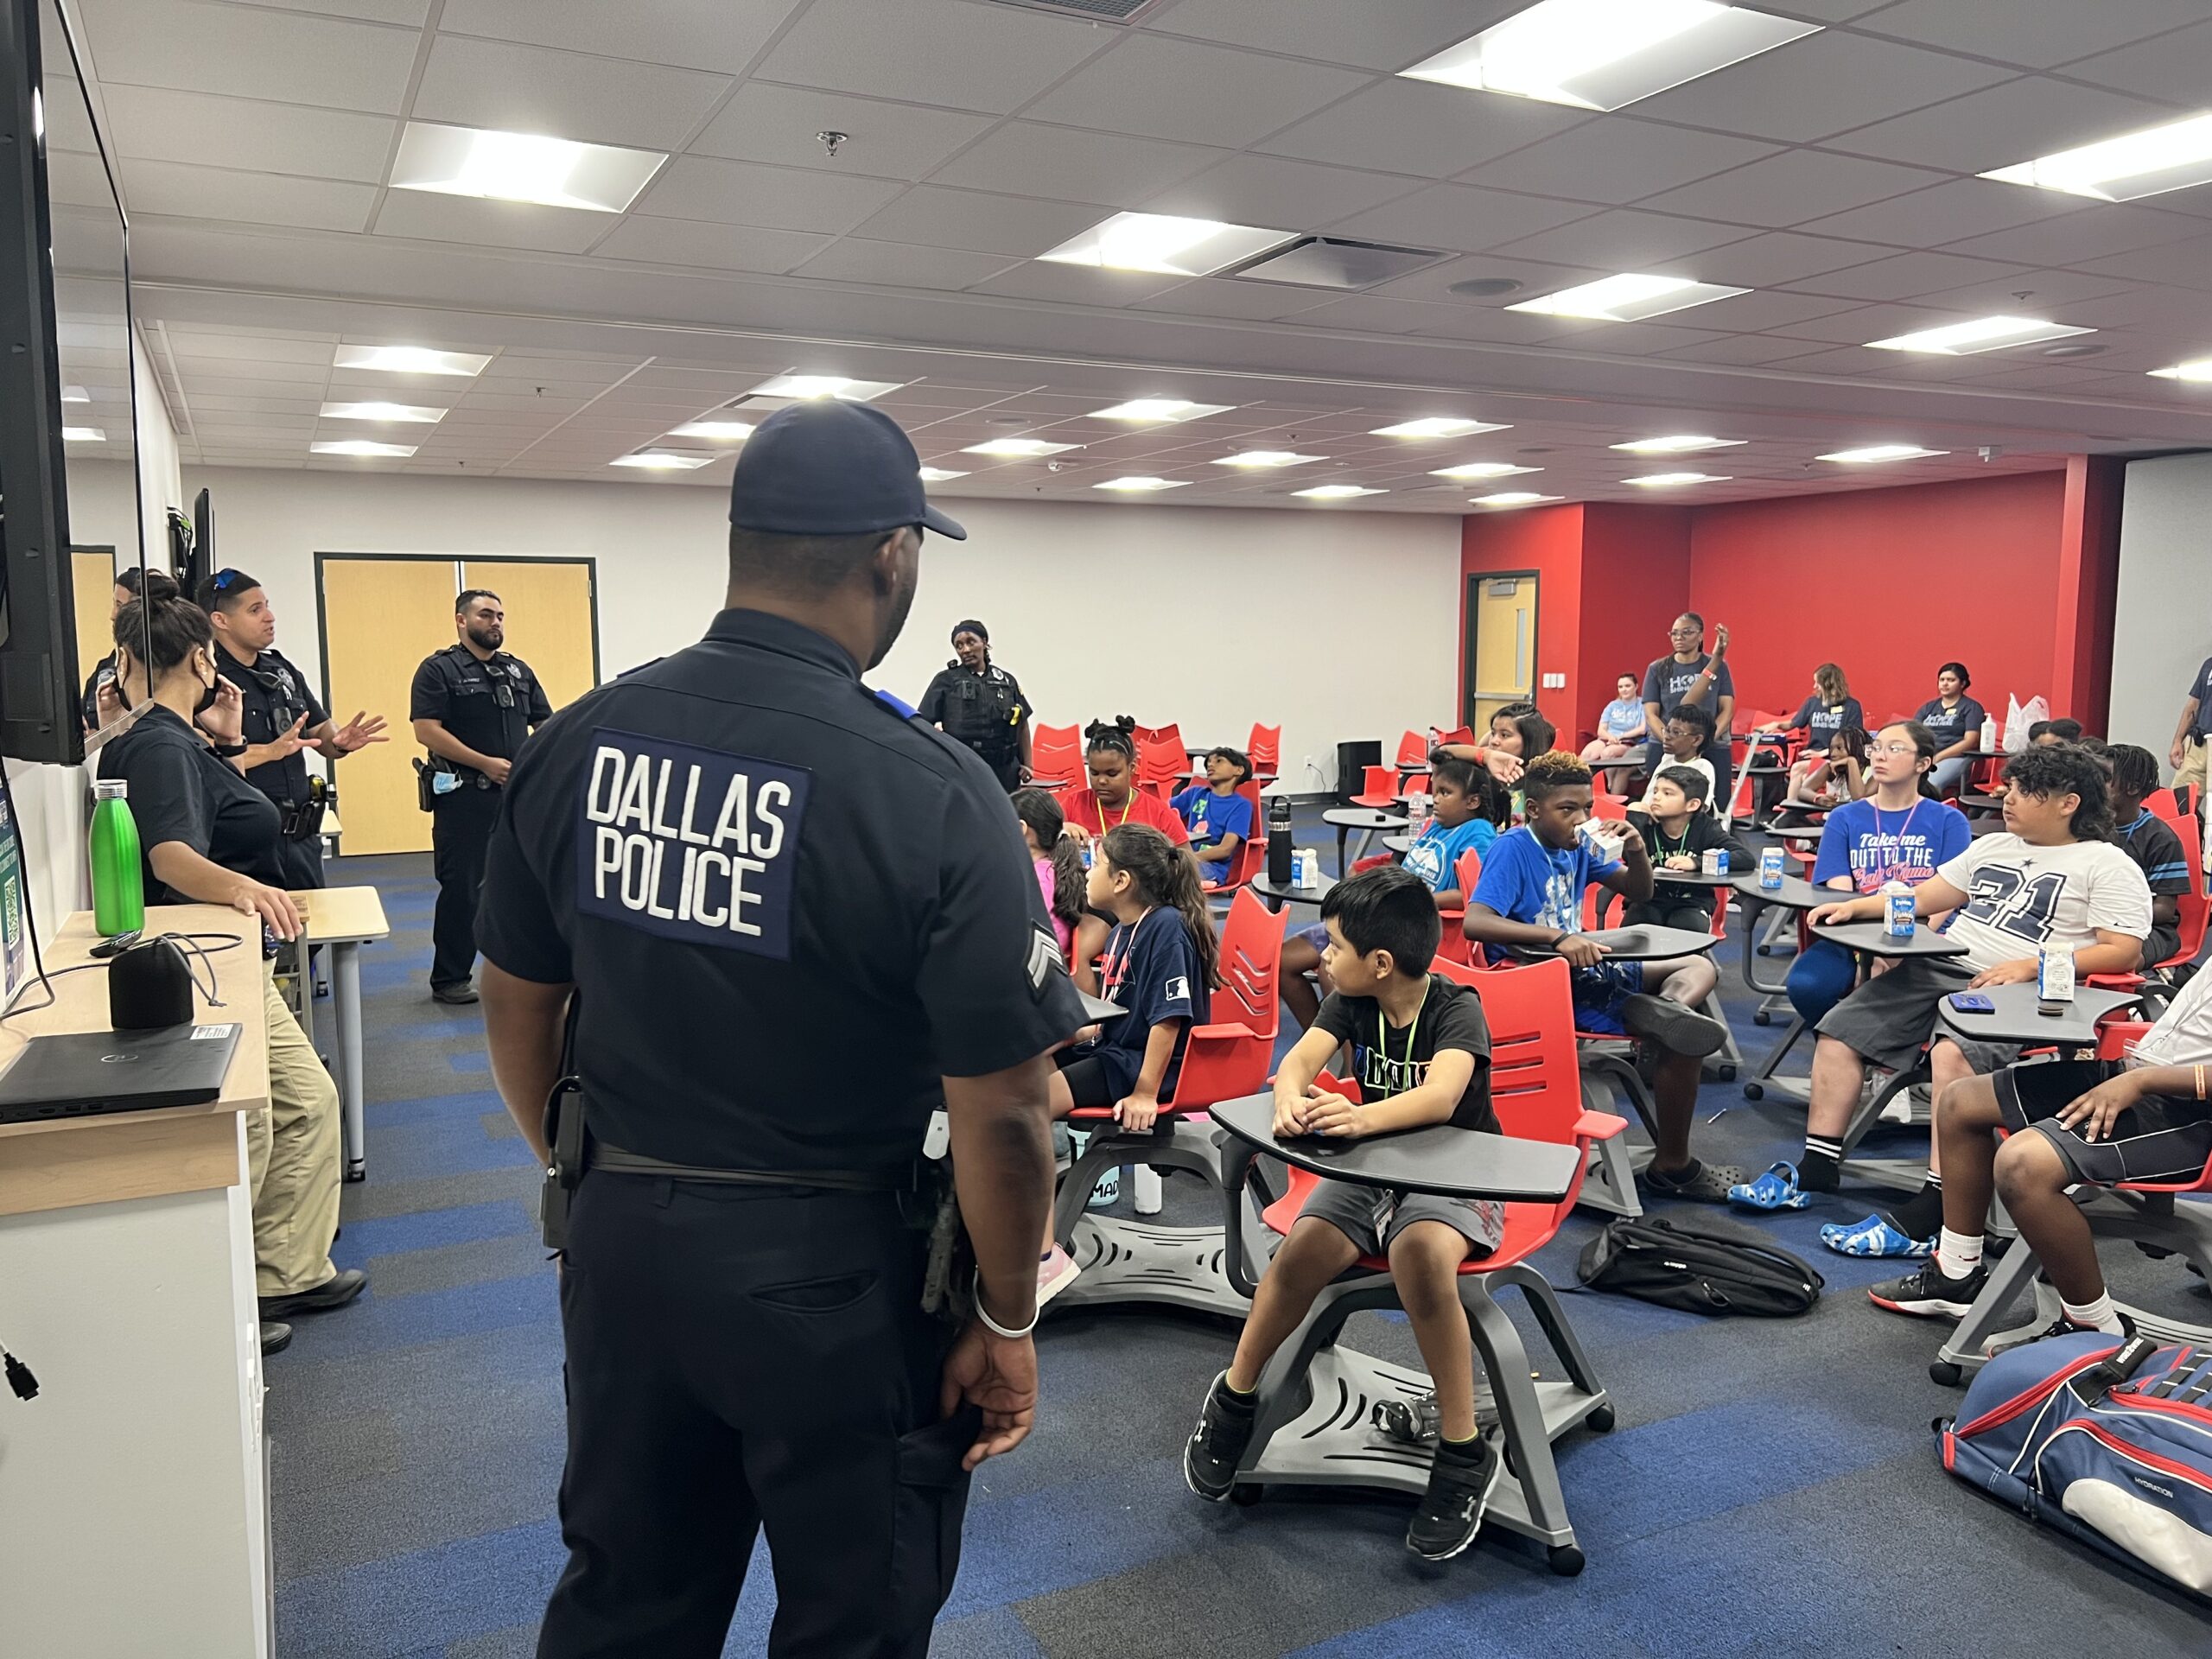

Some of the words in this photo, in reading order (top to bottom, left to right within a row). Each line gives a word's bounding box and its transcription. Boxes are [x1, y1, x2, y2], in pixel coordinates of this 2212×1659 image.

[1812, 712, 1842, 723] HOPE
[586, 746, 791, 859] DALLAS
[1860, 833, 1897, 848] Take
[1900, 835, 1926, 846] me
[1850, 849, 1878, 869] OUT
[1882, 847, 1899, 866] TO
[1904, 847, 1934, 867] THE
[594, 826, 766, 936] POLICE
[1960, 863, 2068, 944] 21
[2134, 1477, 2173, 1498] HYDRATION
